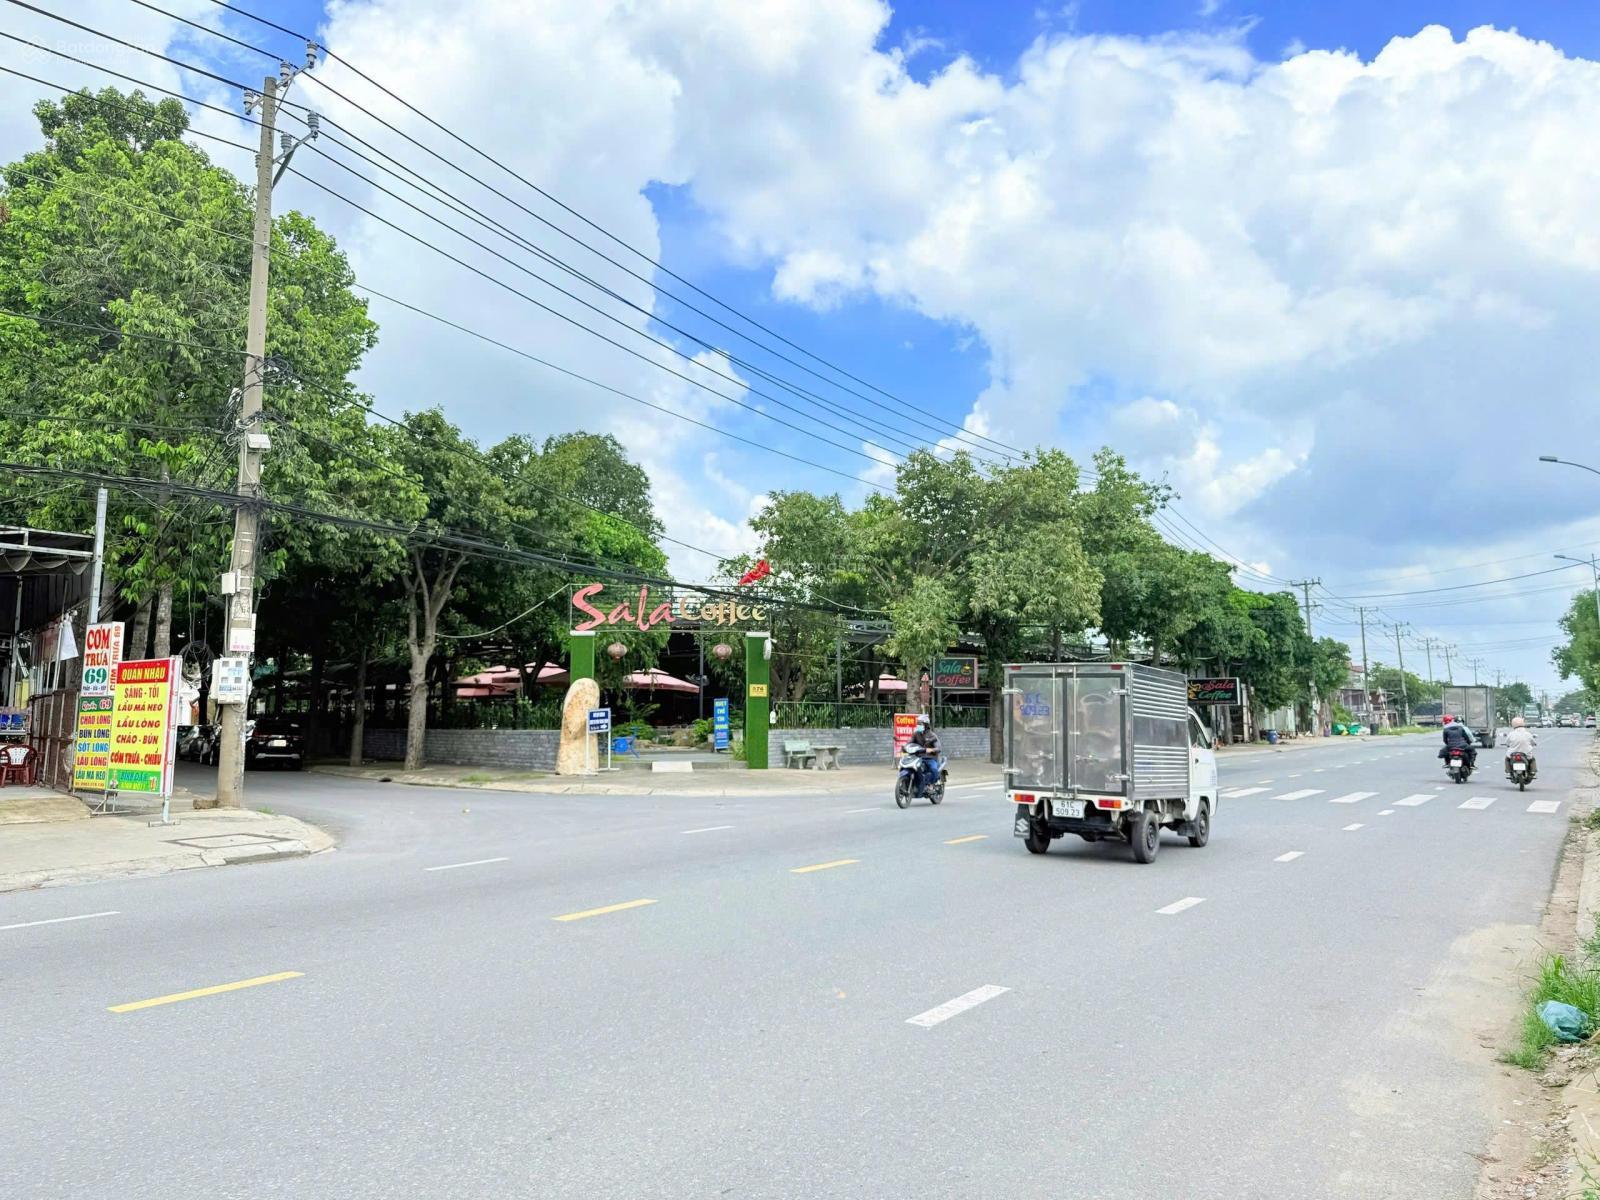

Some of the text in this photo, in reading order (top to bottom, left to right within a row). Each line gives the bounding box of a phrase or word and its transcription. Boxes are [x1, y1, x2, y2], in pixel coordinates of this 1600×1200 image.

[572, 583, 767, 631] Sala Coffee
[87, 625, 111, 650] CƠM
[122, 663, 166, 682] QUÁN NHẬU
[937, 660, 961, 674] Sala
[84, 668, 107, 684] 69
[937, 674, 971, 687] Coffee
